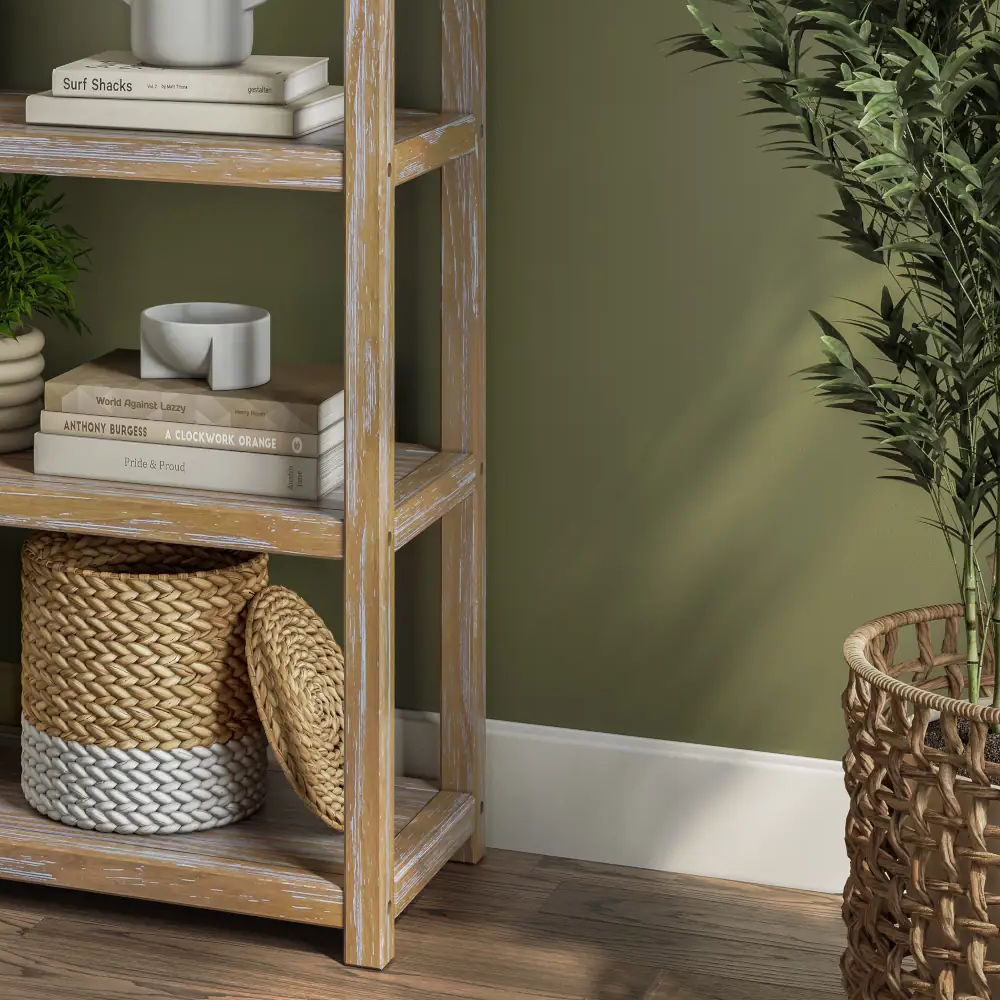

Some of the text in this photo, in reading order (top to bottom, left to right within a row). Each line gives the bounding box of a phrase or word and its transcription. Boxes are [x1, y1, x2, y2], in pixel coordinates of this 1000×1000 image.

[63, 77, 133, 92] Surf Shacks
[96, 396, 186, 414] World Against Lazzy
[63, 420, 148, 438] ANTHONY BURGESS
[164, 429, 277, 450] A CLOCKWORK ORANGE
[124, 457, 186, 472] Pride & Proud
